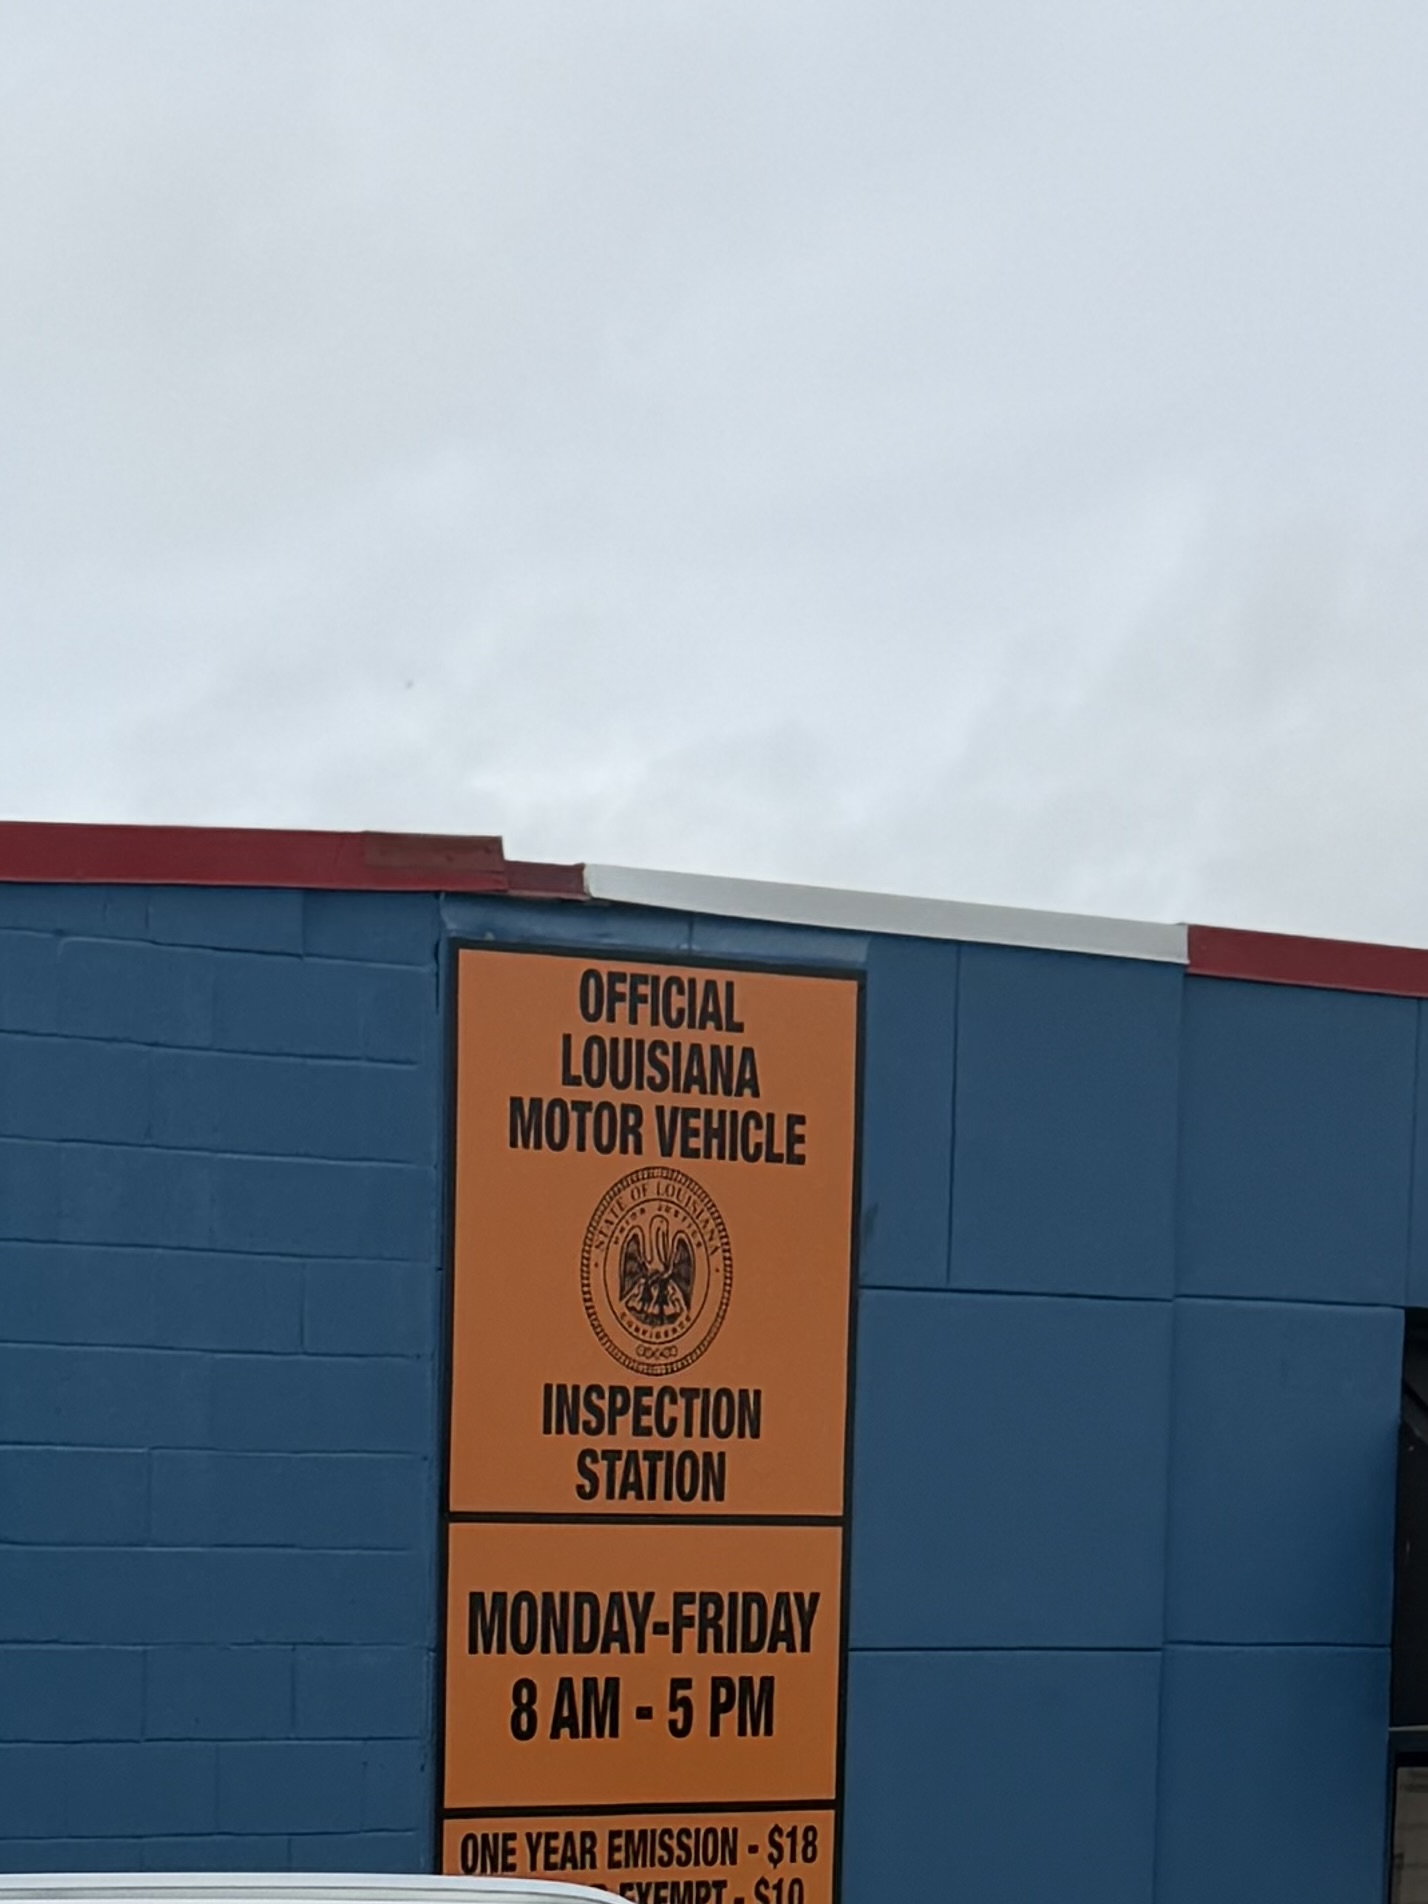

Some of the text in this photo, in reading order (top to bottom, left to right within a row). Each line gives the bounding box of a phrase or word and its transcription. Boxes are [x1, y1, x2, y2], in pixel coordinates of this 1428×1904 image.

[580, 969, 744, 1033] OFFICIAL
[562, 1034, 760, 1098] LOUISIANA
[510, 1097, 806, 1165] MOTOR VEHICLE
[594, 1180, 722, 1257] STATE OF LOUISIANA
[543, 1383, 761, 1439] INSPECTION
[576, 1449, 725, 1501] STATION
[469, 1591, 820, 1655] MONDAY-FRIDAY
[511, 1676, 774, 1741] 8 AM - 5 PM
[461, 1824, 817, 1874] ONE YEAR EMISSION - $18
